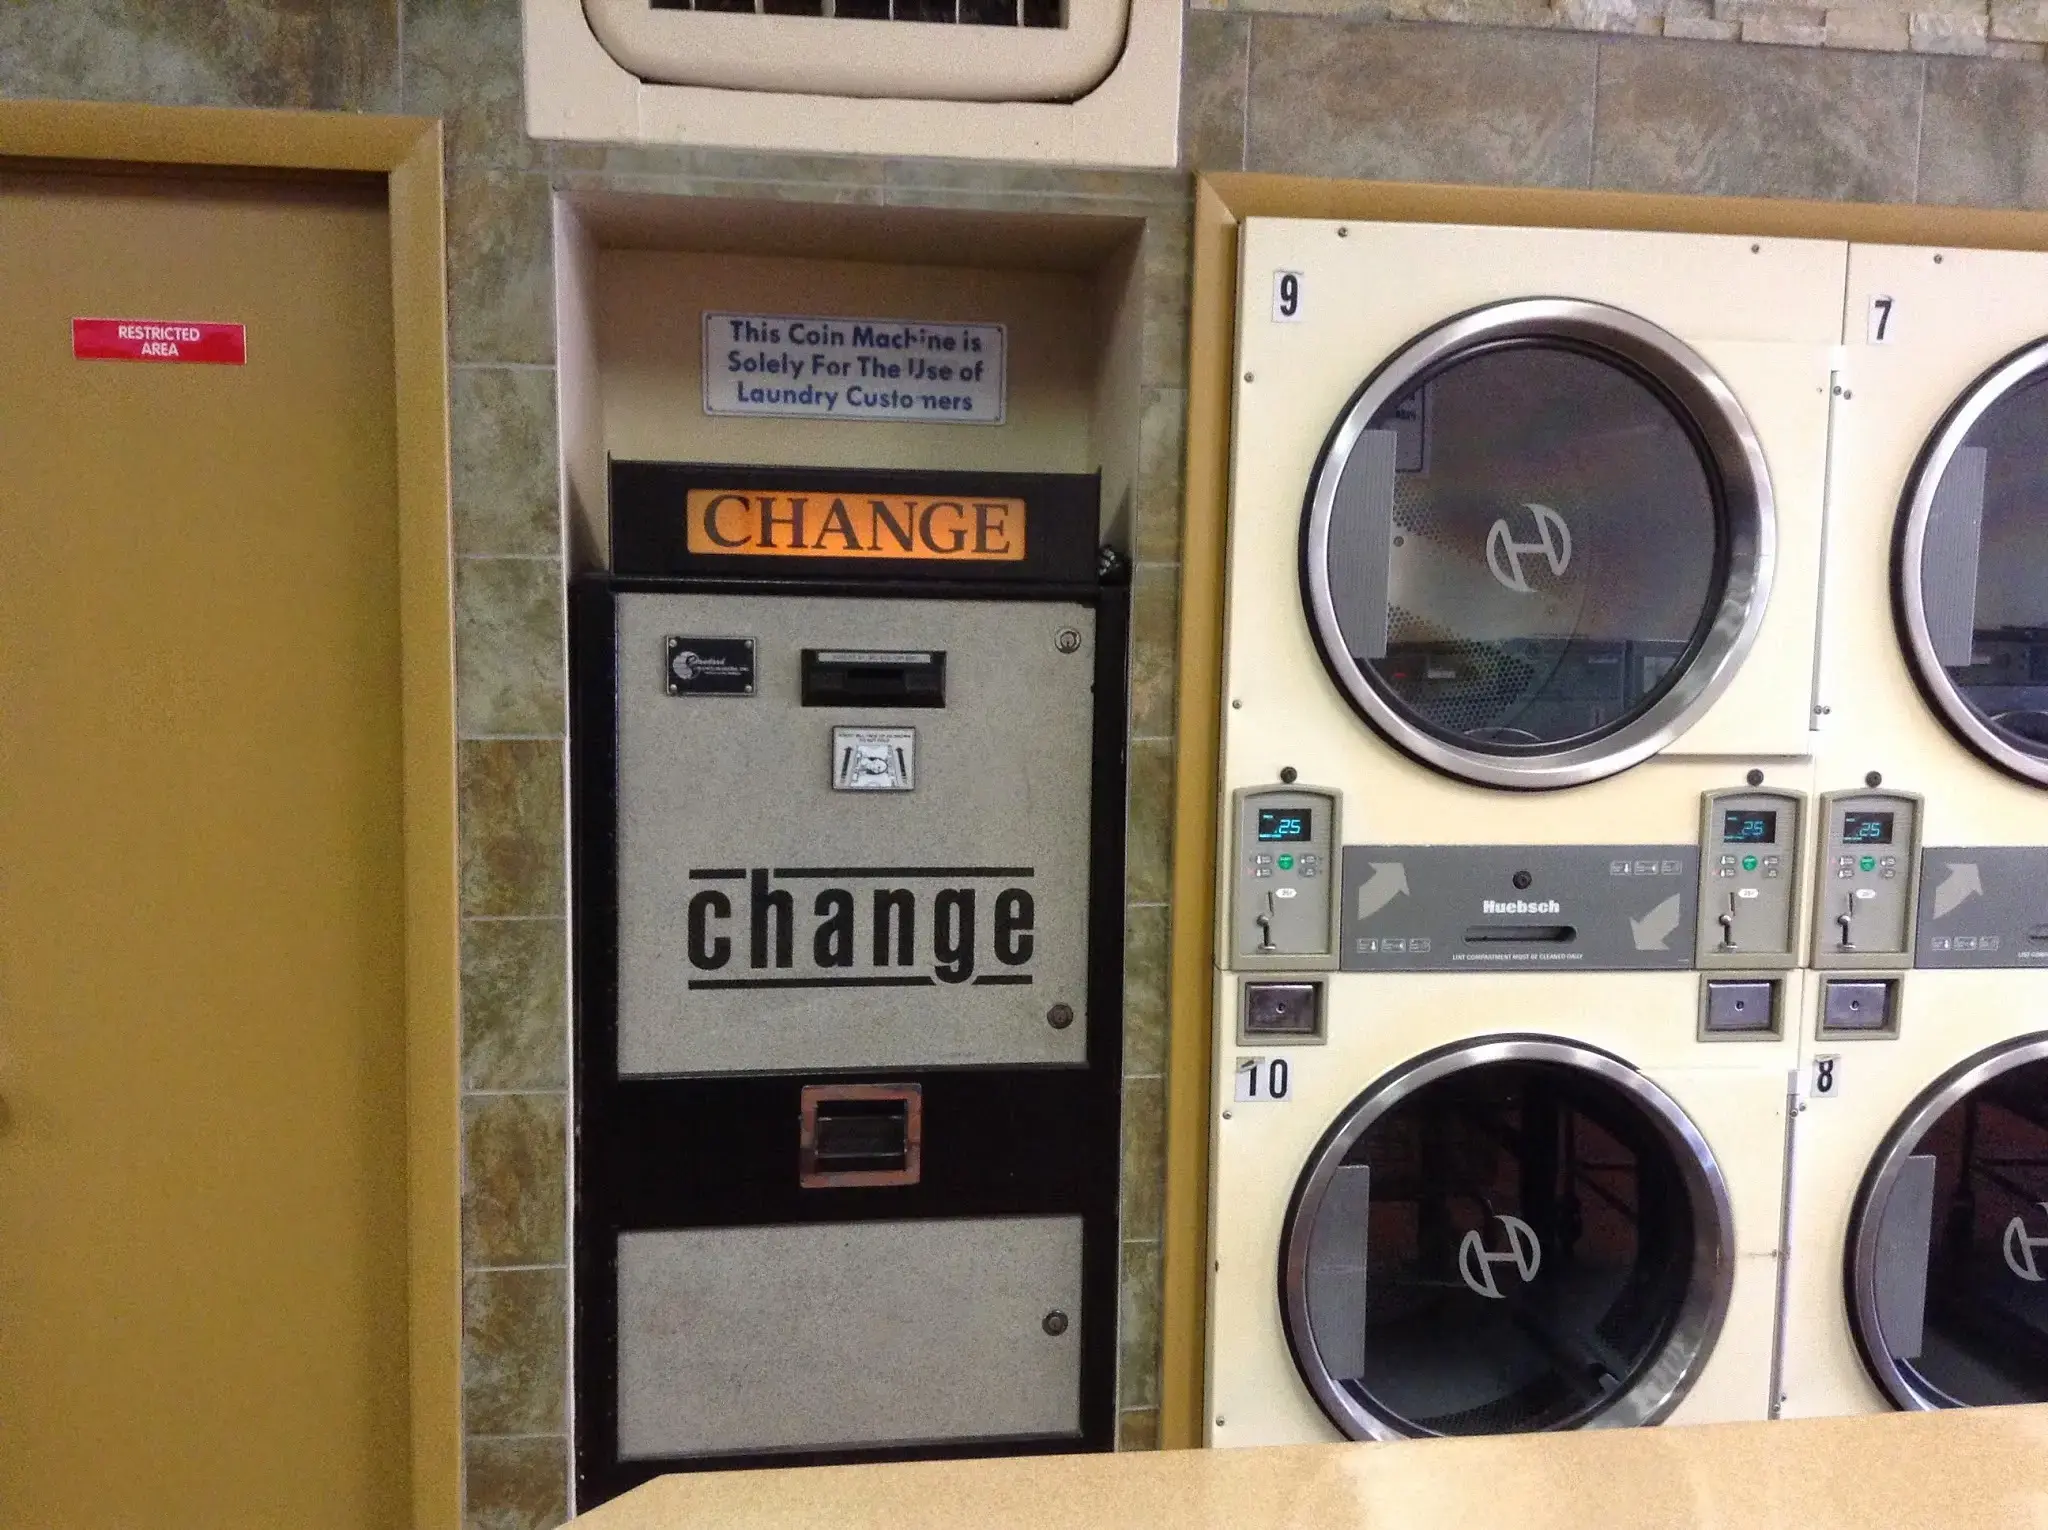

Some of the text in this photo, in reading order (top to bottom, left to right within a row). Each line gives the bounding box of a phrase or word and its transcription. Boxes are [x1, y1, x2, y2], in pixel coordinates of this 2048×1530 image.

[1280, 274, 1298, 317] 9
[118, 325, 200, 342] RESTRICTED
[729, 320, 982, 352] This Coin Machine is
[1875, 299, 1892, 340] 7
[141, 342, 179, 357] AREA
[727, 350, 984, 382] Solely For The Use of
[737, 381, 838, 411] Laundry
[703, 494, 1010, 554] CHANGE
[1482, 899, 1560, 914] Huebsch
[687, 868, 1034, 984] change
[1241, 1058, 1288, 1099] 10
[1817, 1058, 1834, 1093] 8
